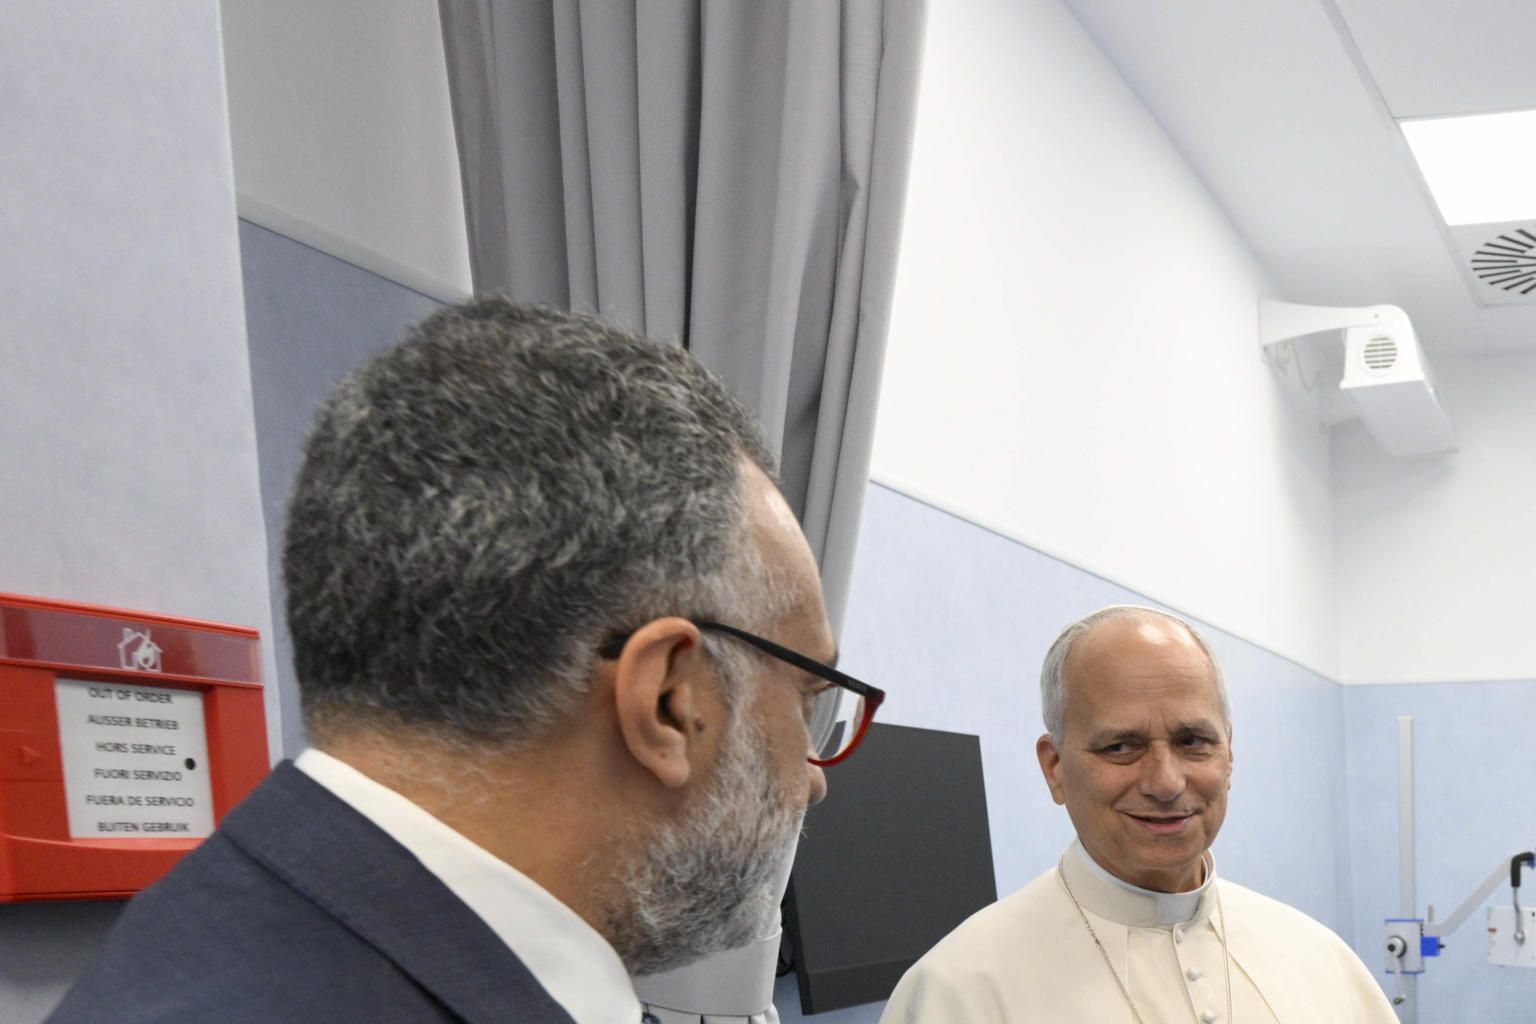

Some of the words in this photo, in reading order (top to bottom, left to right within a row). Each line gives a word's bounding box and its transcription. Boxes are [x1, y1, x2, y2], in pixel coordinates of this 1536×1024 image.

[88, 687, 112, 699] OUT
[115, 689, 132, 701] OF
[134, 691, 173, 704] ORDER
[88, 714, 133, 727] AUSSER
[136, 717, 179, 730] BETRIEB
[95, 742, 129, 753] HORS
[131, 743, 176, 756] SERVICE
[95, 767, 129, 779] FUORI
[132, 769, 182, 781] SERVIZIO
[86, 794, 125, 806] FUERA
[127, 795, 143, 806] DE
[144, 796, 194, 807] SERVICIO
[98, 822, 139, 832] BUITEN
[142, 822, 190, 832] GEBRUIK
